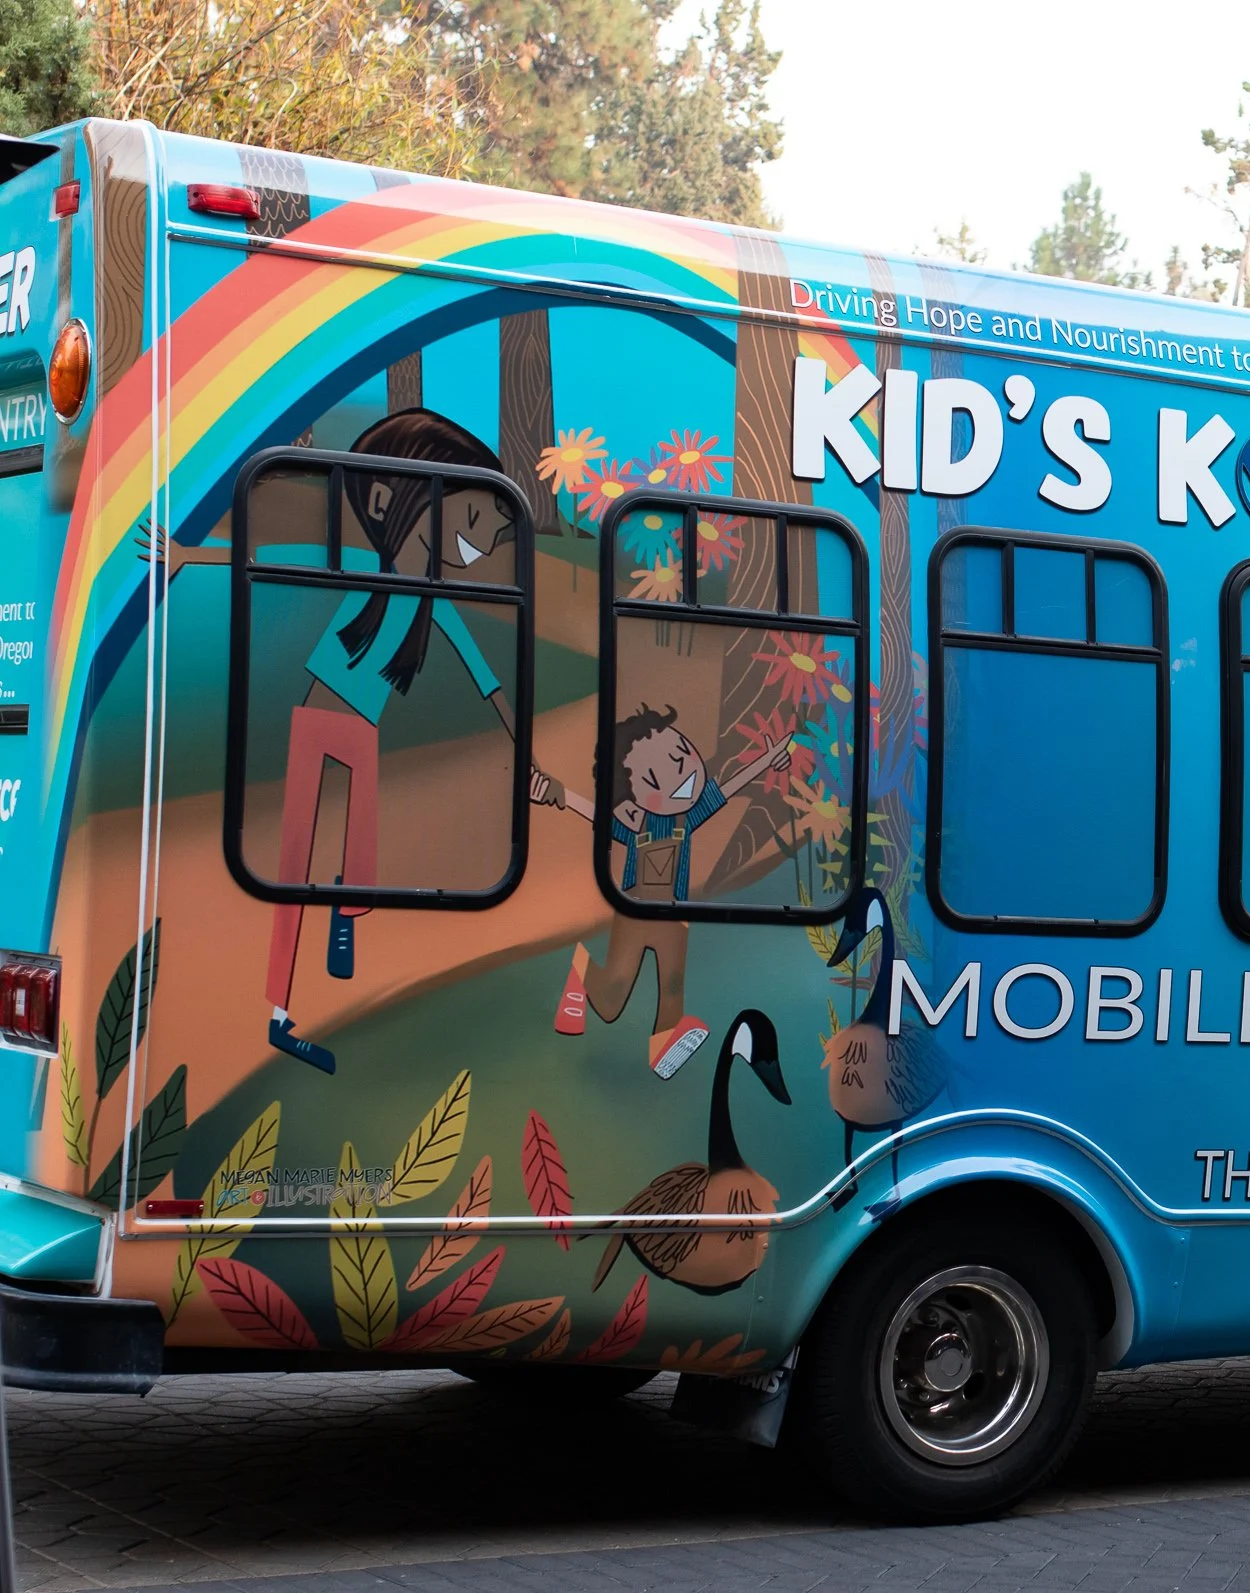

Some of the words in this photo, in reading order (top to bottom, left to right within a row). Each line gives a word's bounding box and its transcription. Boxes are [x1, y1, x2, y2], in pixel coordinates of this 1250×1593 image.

[790, 278, 896, 327] Driving
[906, 297, 983, 336] Hope
[991, 311, 1041, 342] and
[1052, 318, 1224, 369] Nourishment
[0, 602, 23, 622] ent
[284, 1167, 336, 1185] MARIE
[340, 1167, 393, 1185] MYERS
